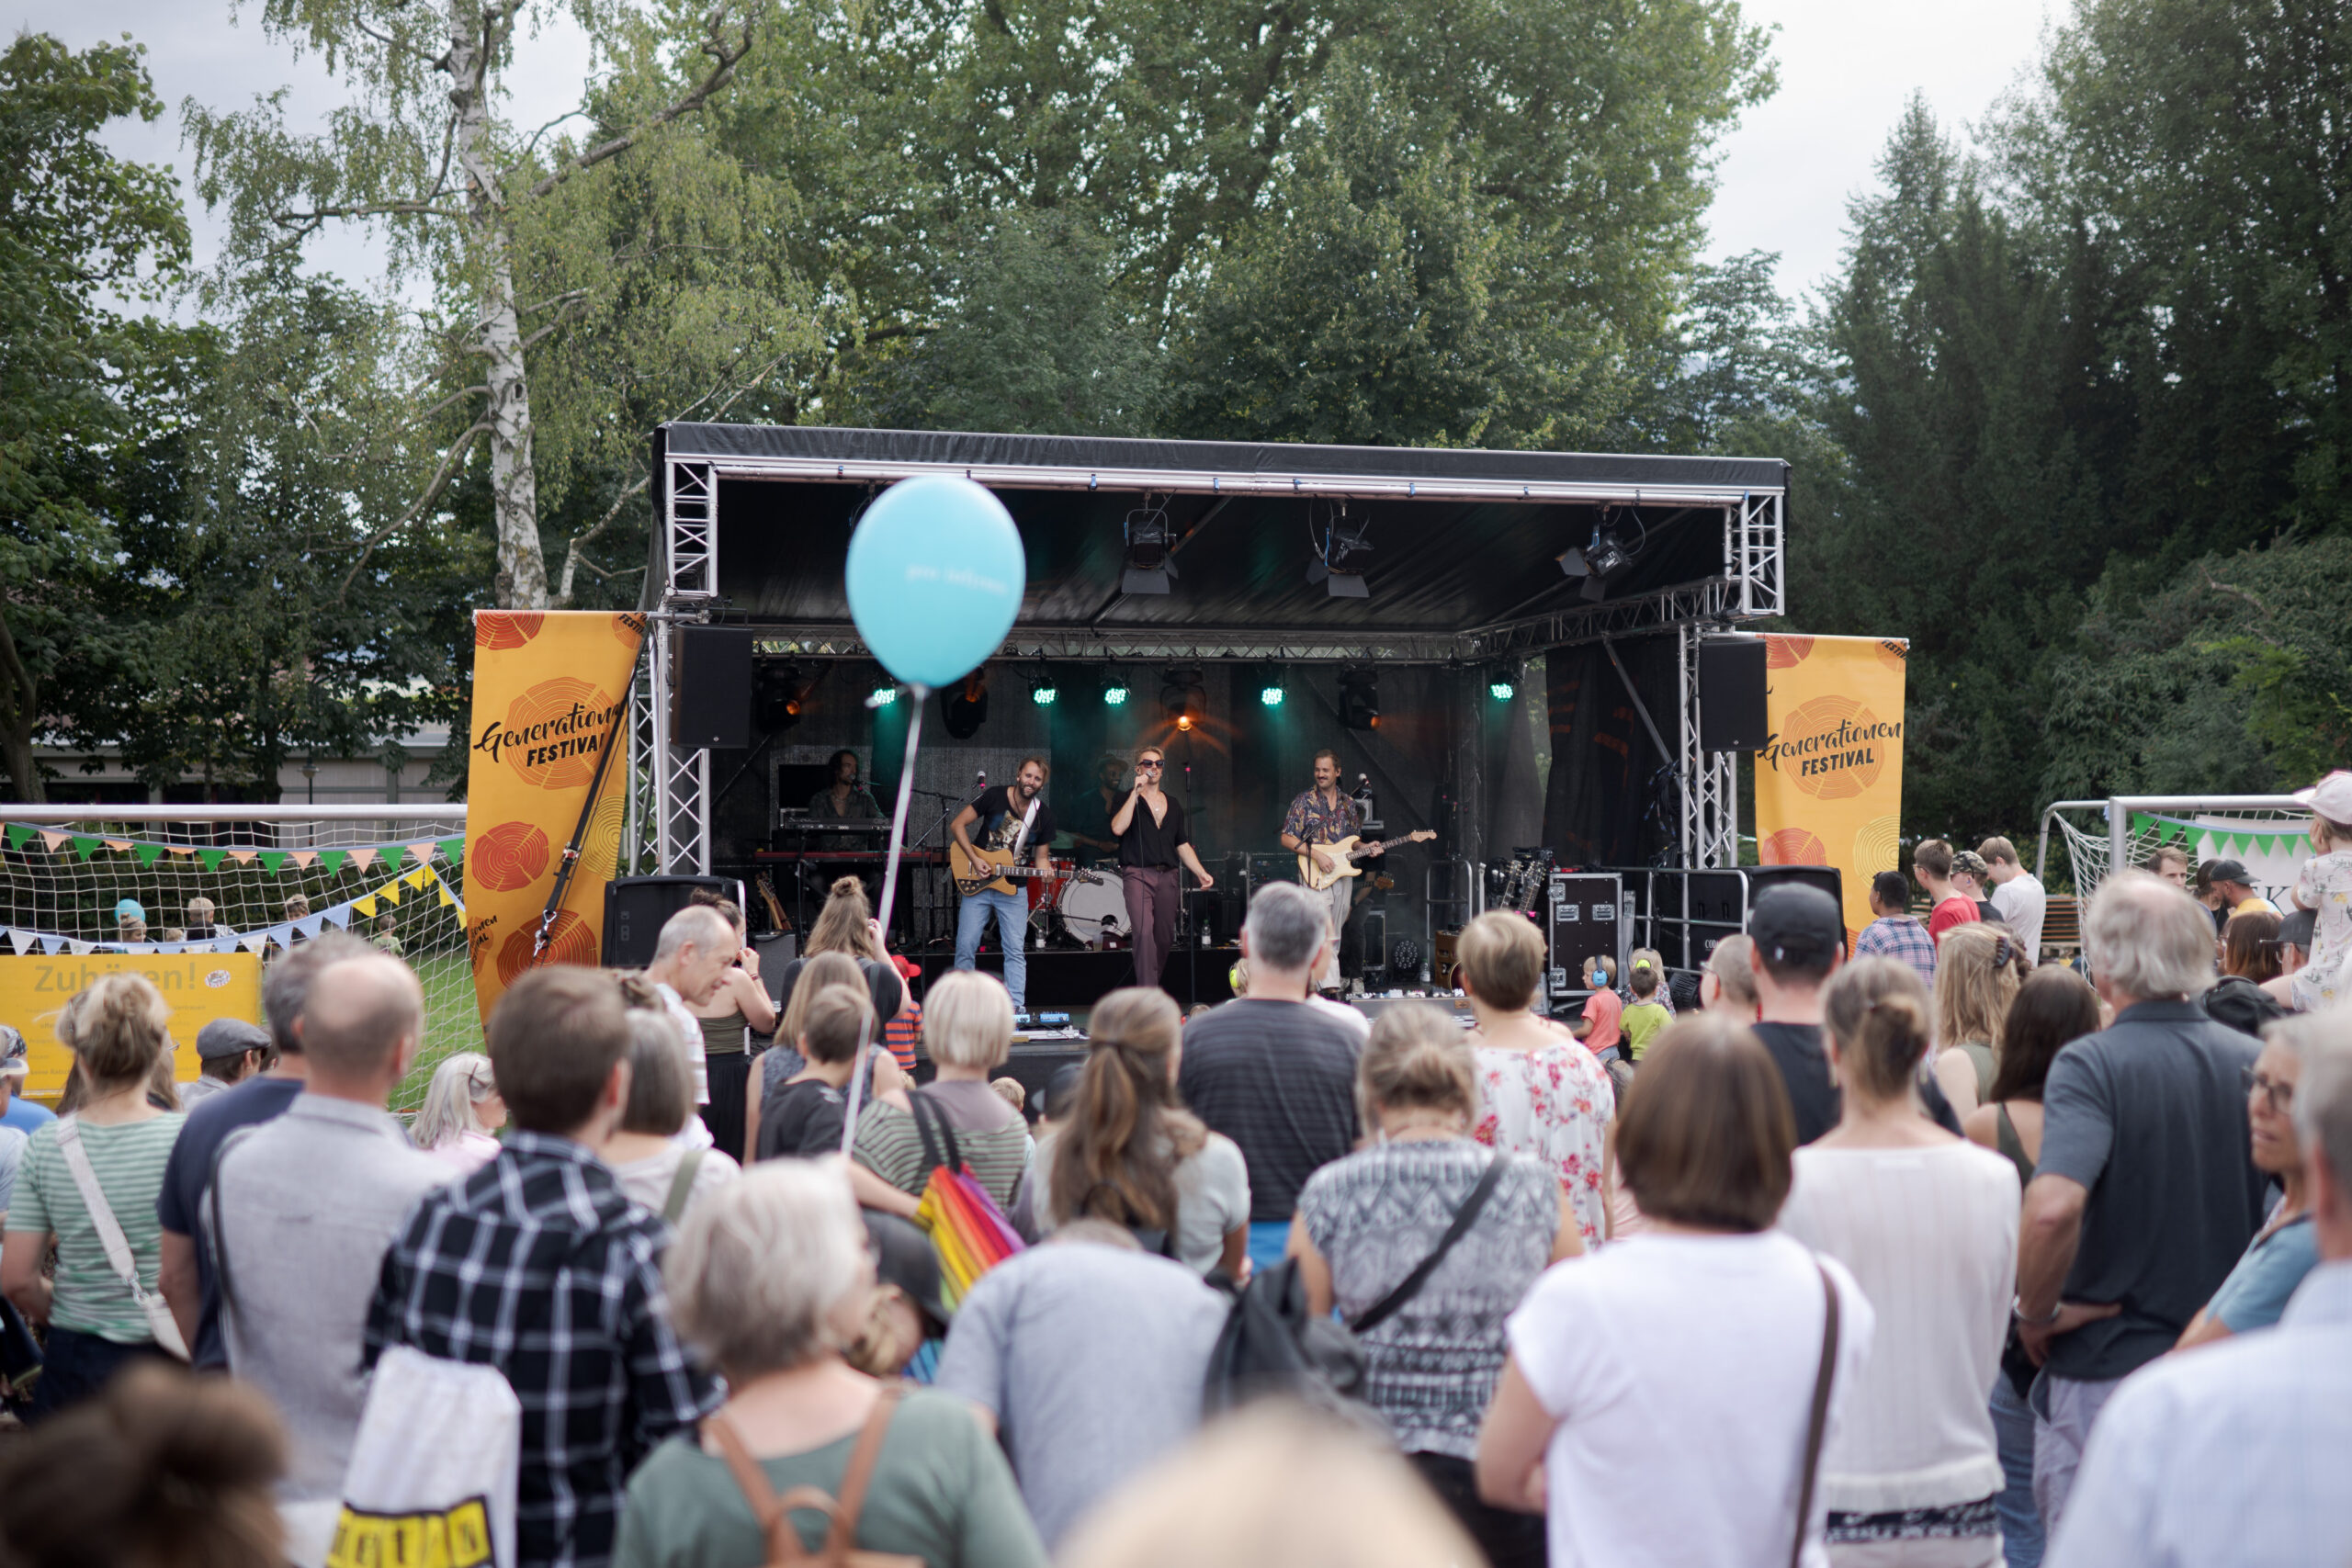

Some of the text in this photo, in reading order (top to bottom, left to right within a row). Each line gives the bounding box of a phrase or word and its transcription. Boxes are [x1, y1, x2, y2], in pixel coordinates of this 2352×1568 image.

[473, 702, 624, 763] Generation
[1757, 719, 1901, 773] Generationen
[1802, 748, 1874, 776] FESTIVAL
[1705, 939, 1719, 949] COD
[34, 962, 195, 992] Zuhen!
